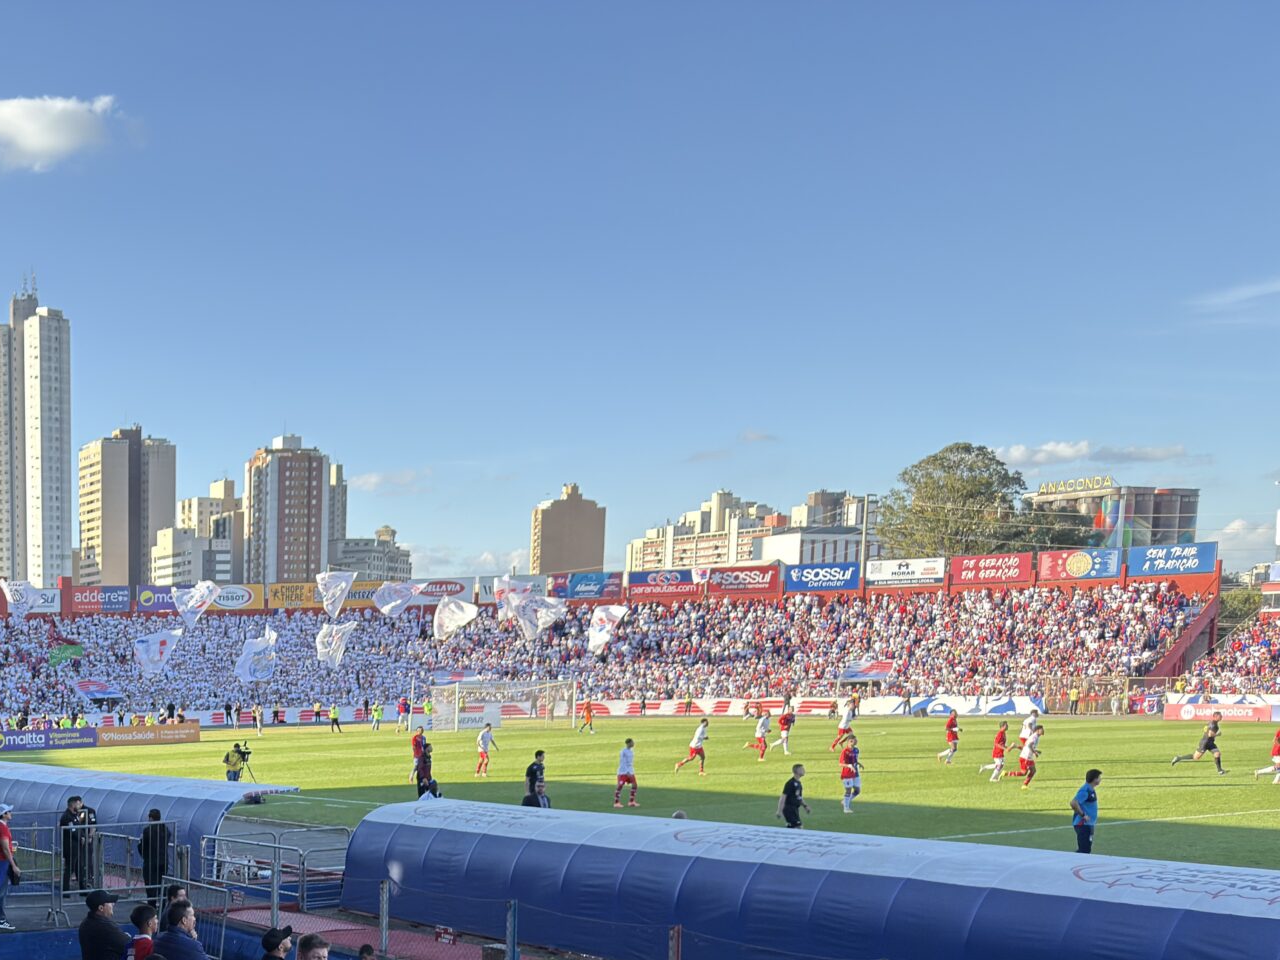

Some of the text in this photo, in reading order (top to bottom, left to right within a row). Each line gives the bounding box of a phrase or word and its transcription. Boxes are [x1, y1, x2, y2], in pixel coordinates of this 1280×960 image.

[1146, 546, 1198, 559] SEM TRAIR
[962, 556, 1020, 569] DE GERAÇÃO
[1142, 555, 1199, 571] A TRADIÇÃO
[722, 571, 771, 584] SOSSul
[801, 567, 852, 581] SOSSul
[961, 568, 1020, 580] EM GERAÇÃO
[280, 585, 304, 593] CHOPP
[631, 584, 697, 595] paranautas.com
[808, 580, 845, 588] Defender
[74, 590, 118, 602] addere
[1196, 707, 1253, 717] webmotors
[5, 733, 45, 744] maltta
[49, 731, 80, 739] Vitaminas
[110, 731, 155, 741] NossaSaúde
[54, 737, 94, 747] Suplementos
